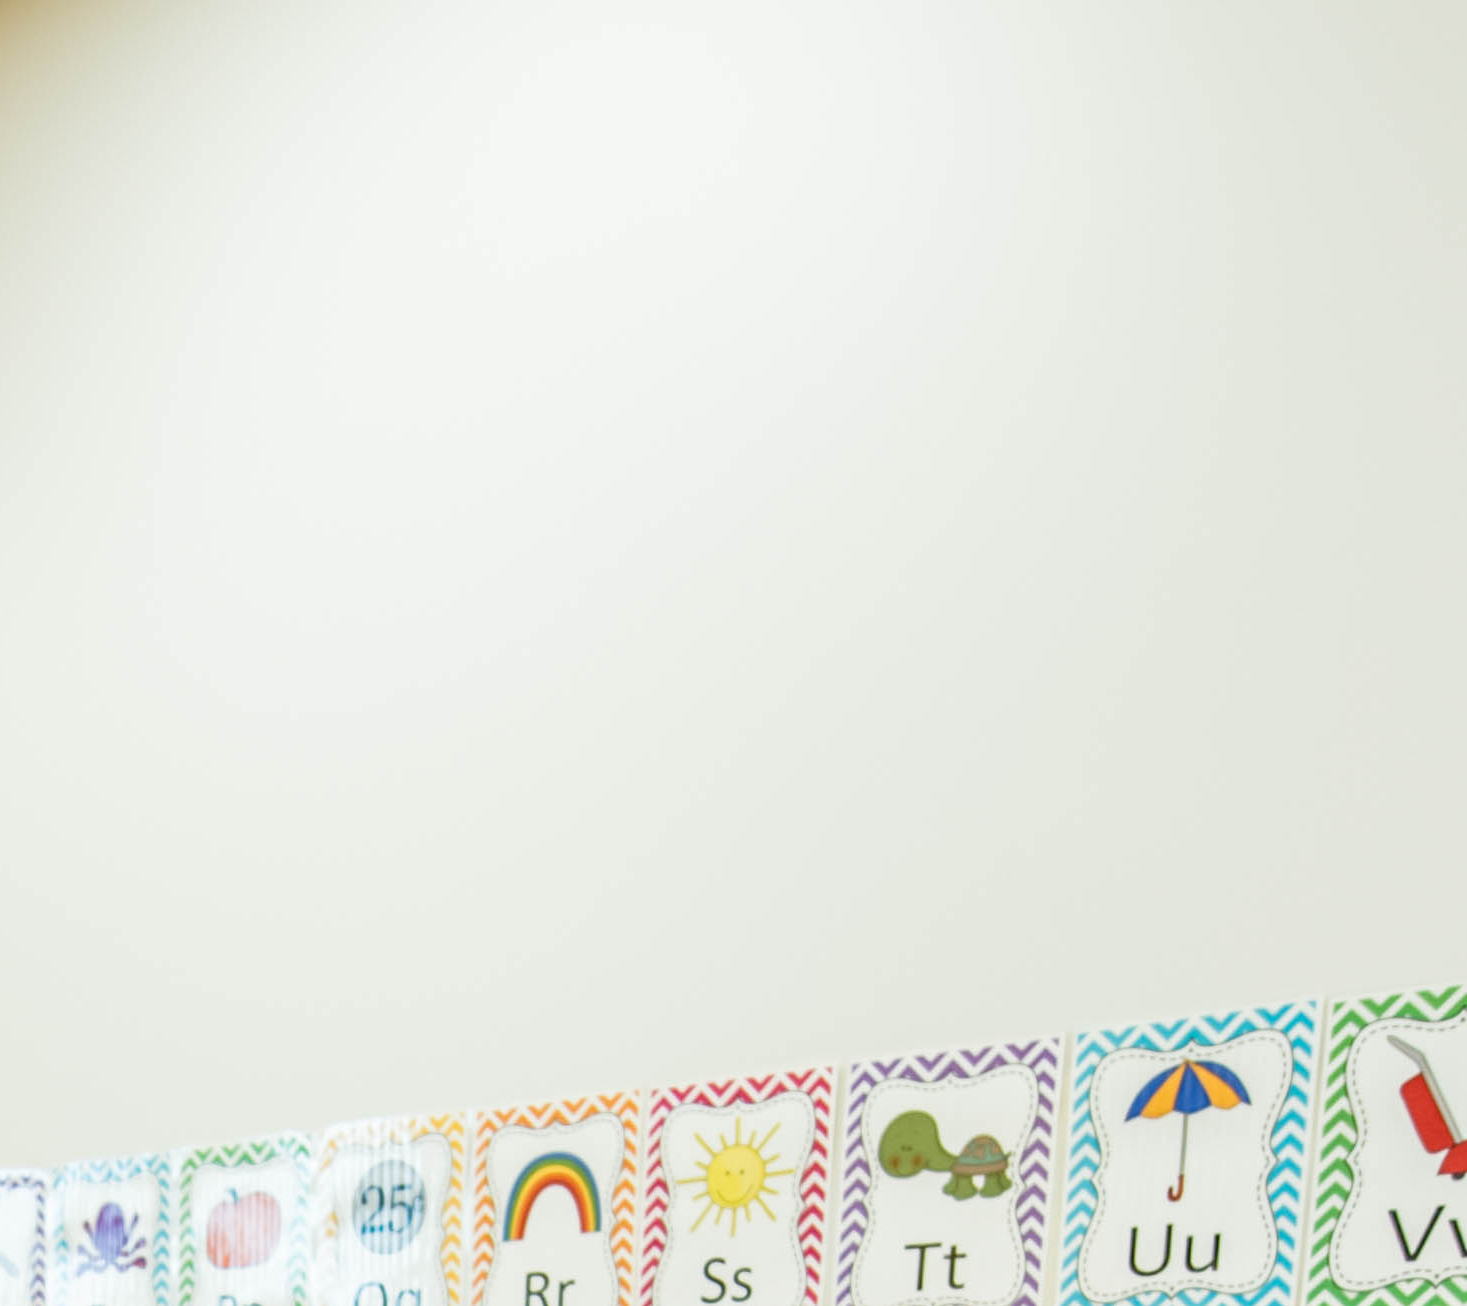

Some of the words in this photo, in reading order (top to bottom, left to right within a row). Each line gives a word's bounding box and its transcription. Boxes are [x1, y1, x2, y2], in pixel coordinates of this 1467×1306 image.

[904, 1242, 968, 1292] Tt
[1128, 1223, 1222, 1277] Uu
[699, 1257, 753, 1304] Ss
